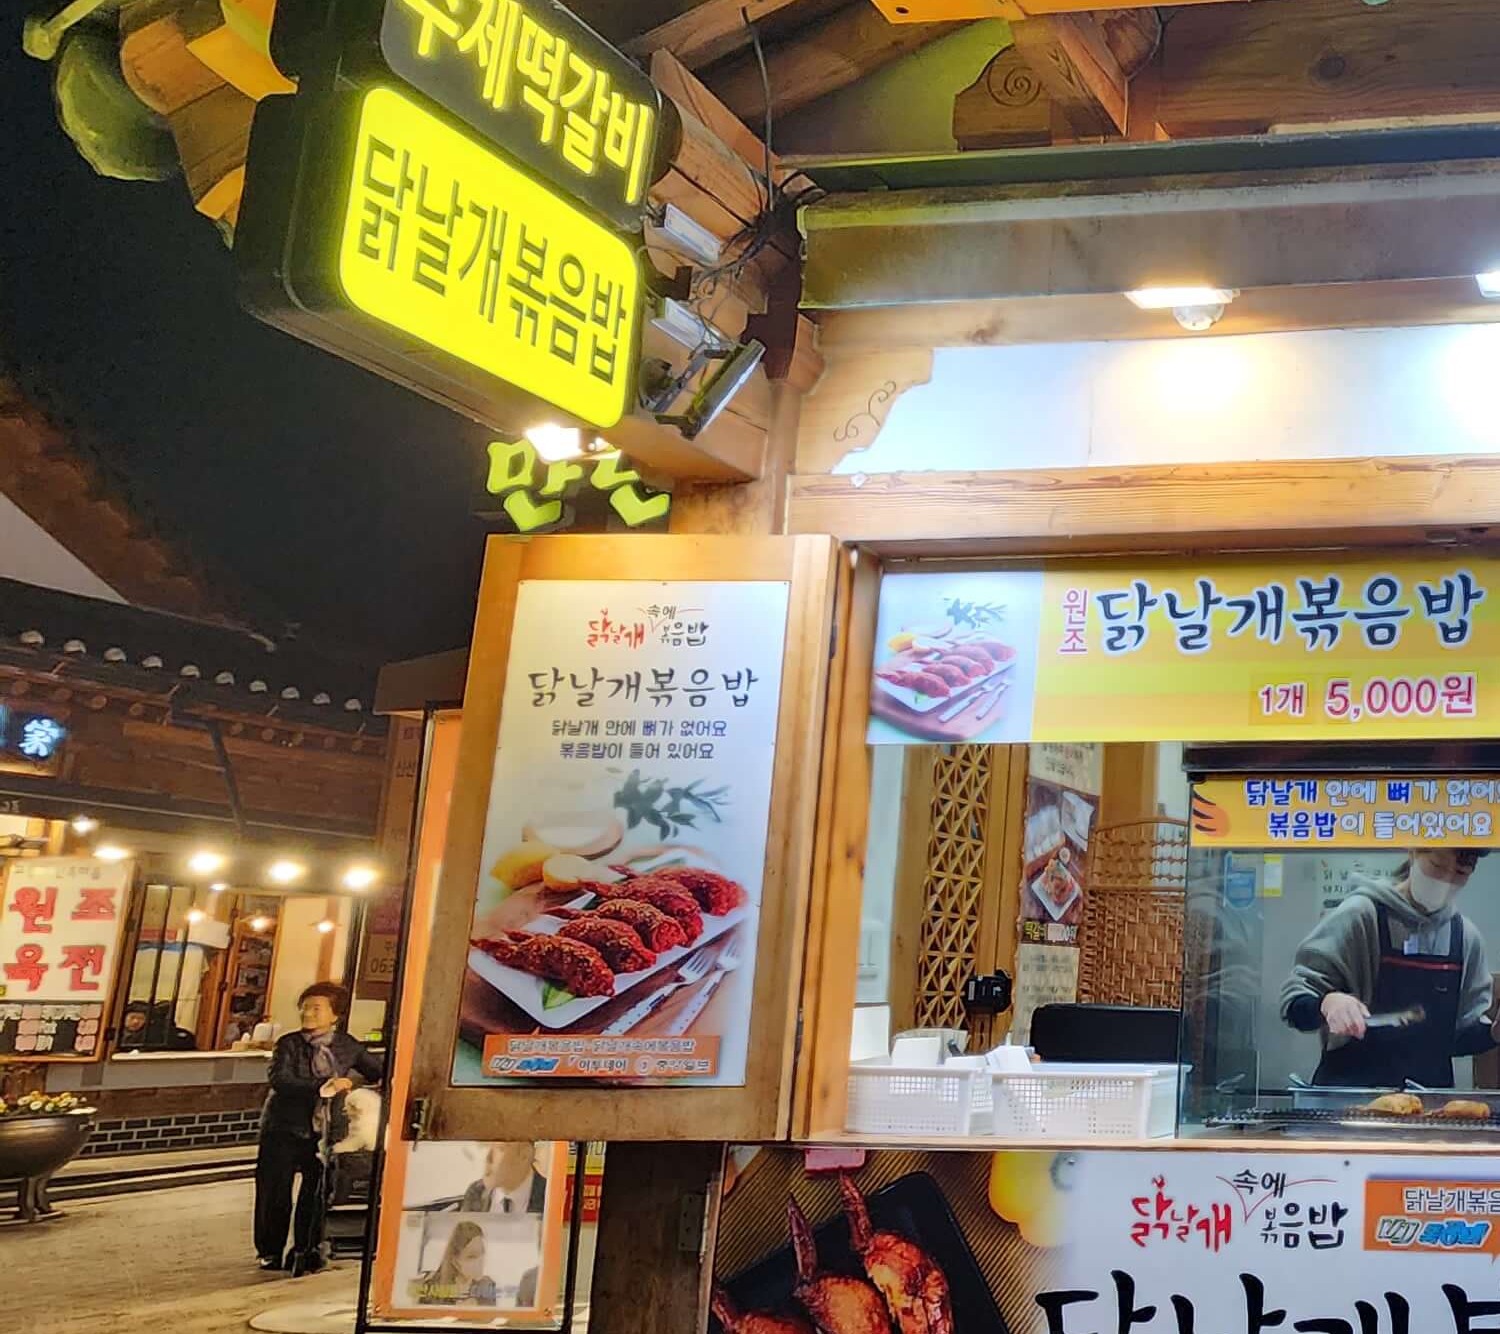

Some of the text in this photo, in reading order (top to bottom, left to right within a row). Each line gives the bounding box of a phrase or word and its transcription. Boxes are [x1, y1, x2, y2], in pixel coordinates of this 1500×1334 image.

[356, 135, 628, 387] 닭날개볶음밥
[587, 603, 709, 649] 닭날개 속에 볶음밥
[1060, 587, 1088, 653] 원조
[1096, 571, 1484, 651] 닭날개볶음밥
[527, 666, 760, 708] 닭날개볶음밥
[1260, 675, 1477, 719] 1개 5,000원
[551, 720, 728, 736] 닭날개 안에 뼈가 없어요
[560, 742, 715, 759] 볶음밥이 들어 있어요
[1246, 778, 1318, 807] 닭날개
[1324, 779, 1377, 806] 안에
[1387, 779, 1438, 805] 뼈가
[1268, 811, 1494, 839] 볶음밥이 들어있어요
[1130, 1169, 1349, 1253] 닭날개 속에 볶음밥
